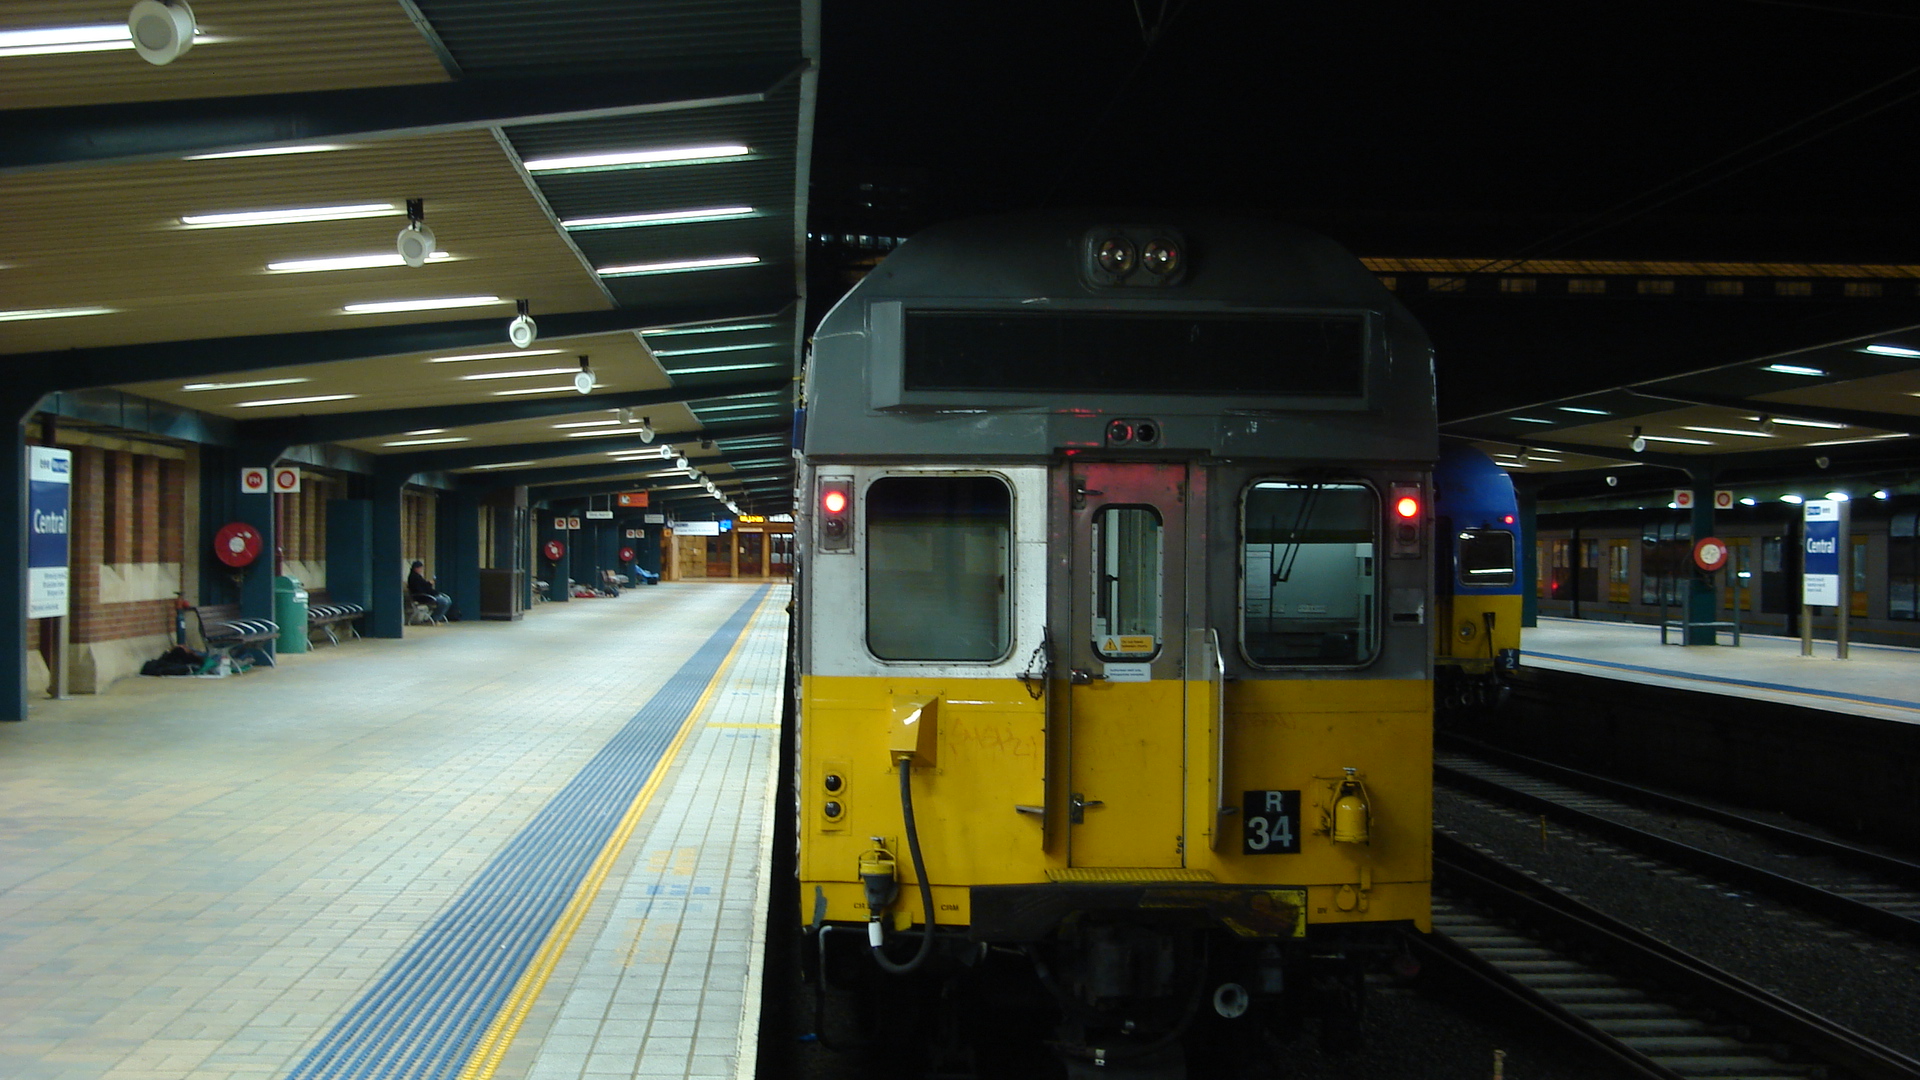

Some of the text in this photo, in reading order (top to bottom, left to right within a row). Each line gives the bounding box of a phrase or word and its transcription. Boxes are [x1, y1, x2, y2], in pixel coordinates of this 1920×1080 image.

[34, 508, 67, 534] Central
[1807, 537, 1836, 554] Central
[1506, 657, 1514, 669] 2
[1266, 791, 1282, 812] R
[1248, 815, 1293, 850] 34
